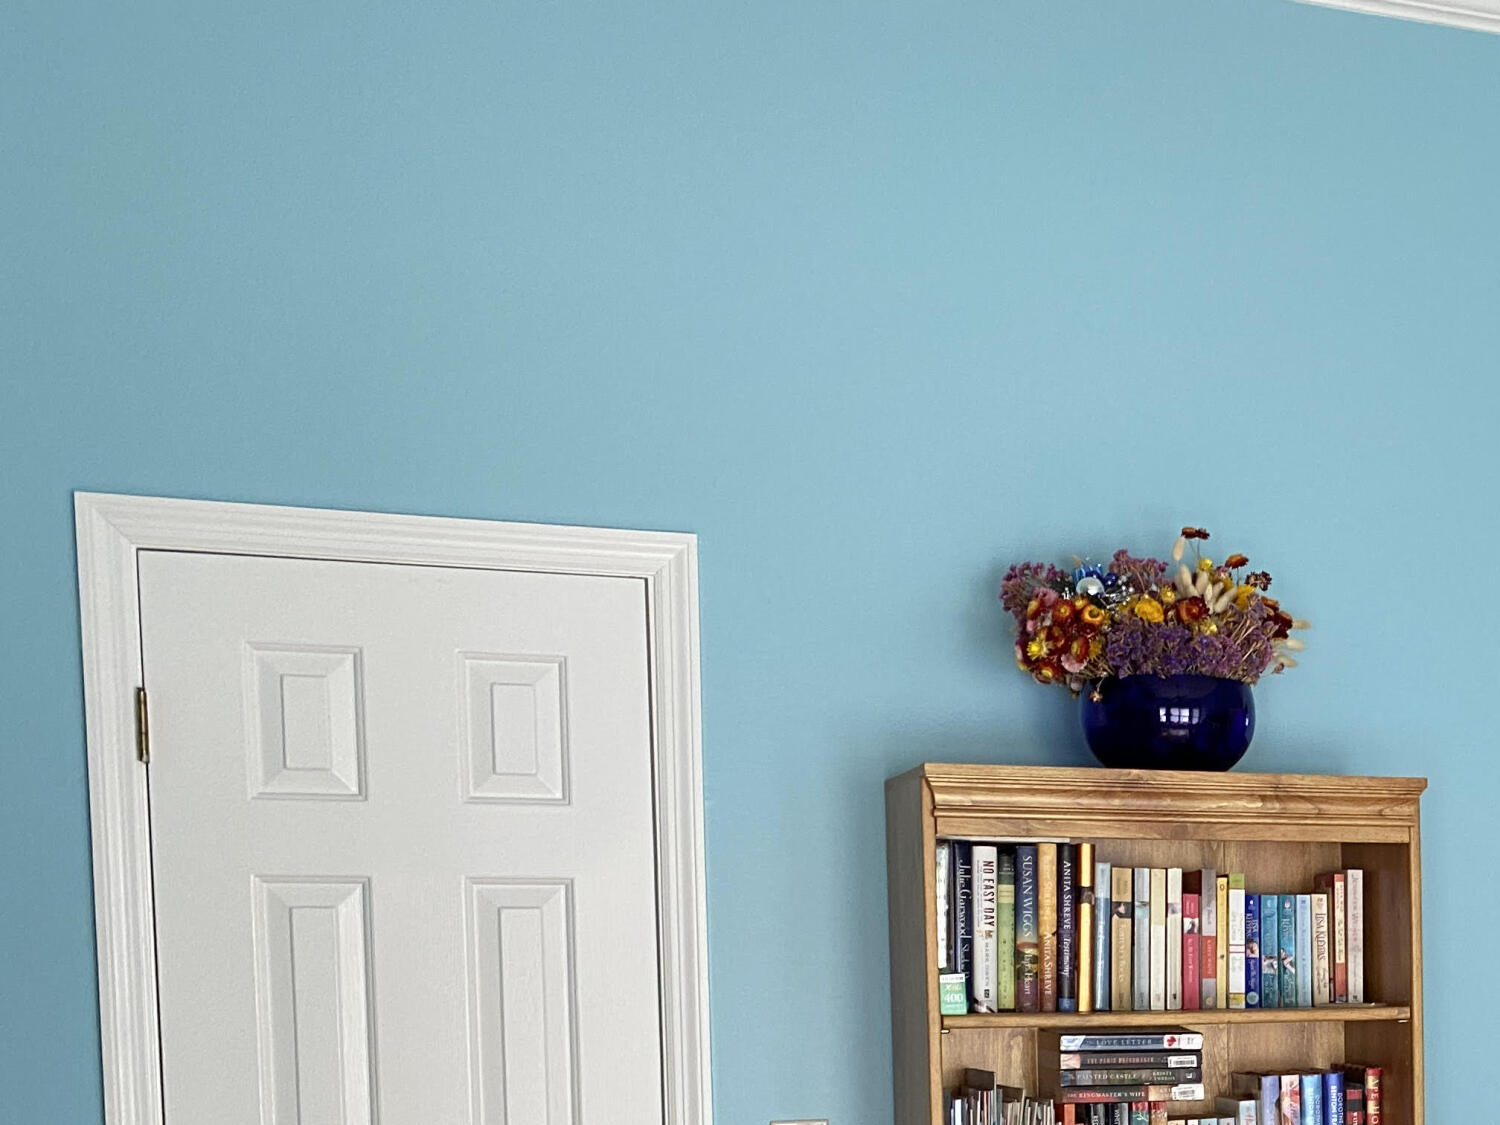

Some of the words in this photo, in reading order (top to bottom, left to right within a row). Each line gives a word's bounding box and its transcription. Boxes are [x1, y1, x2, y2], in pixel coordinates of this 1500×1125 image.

[983, 860, 995, 875] NO
[1022, 855, 1034, 897] SUSAN
[1062, 860, 1073, 893] ANITA
[983, 878, 995, 904] EASY
[983, 908, 995, 928] DAY
[1022, 898, 1034, 938] WIGGS
[1062, 894, 1073, 931] SHREVE
[1315, 912, 1327, 929] LISA
[1043, 932, 1053, 961] ANITA
[1043, 961, 1053, 996] SHREVE
[1129, 1089, 1146, 1098] WIFE
[1330, 1085, 1339, 1113] BENTON
[1370, 1078, 1380, 1100] APE
